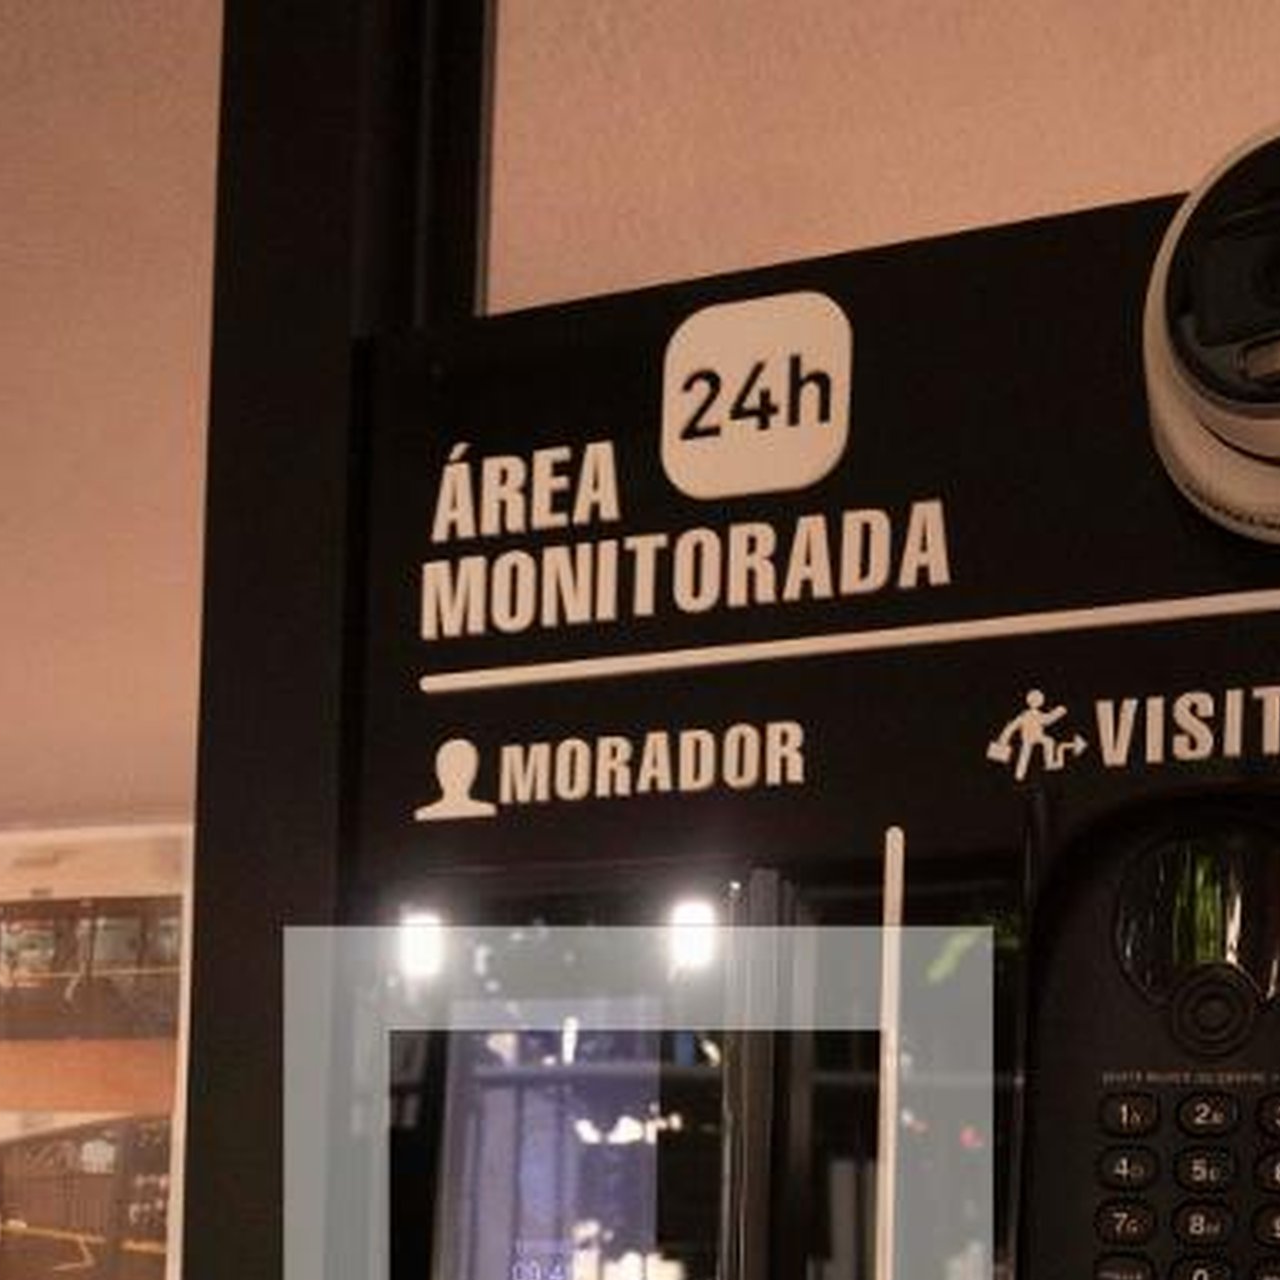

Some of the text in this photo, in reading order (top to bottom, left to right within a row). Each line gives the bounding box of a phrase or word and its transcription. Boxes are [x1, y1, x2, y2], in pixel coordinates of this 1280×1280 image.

[679, 354, 832, 441] 24h
[431, 440, 620, 543] ÁREA
[421, 498, 951, 640] MONITORADA
[498, 721, 806, 805] MORADOR
